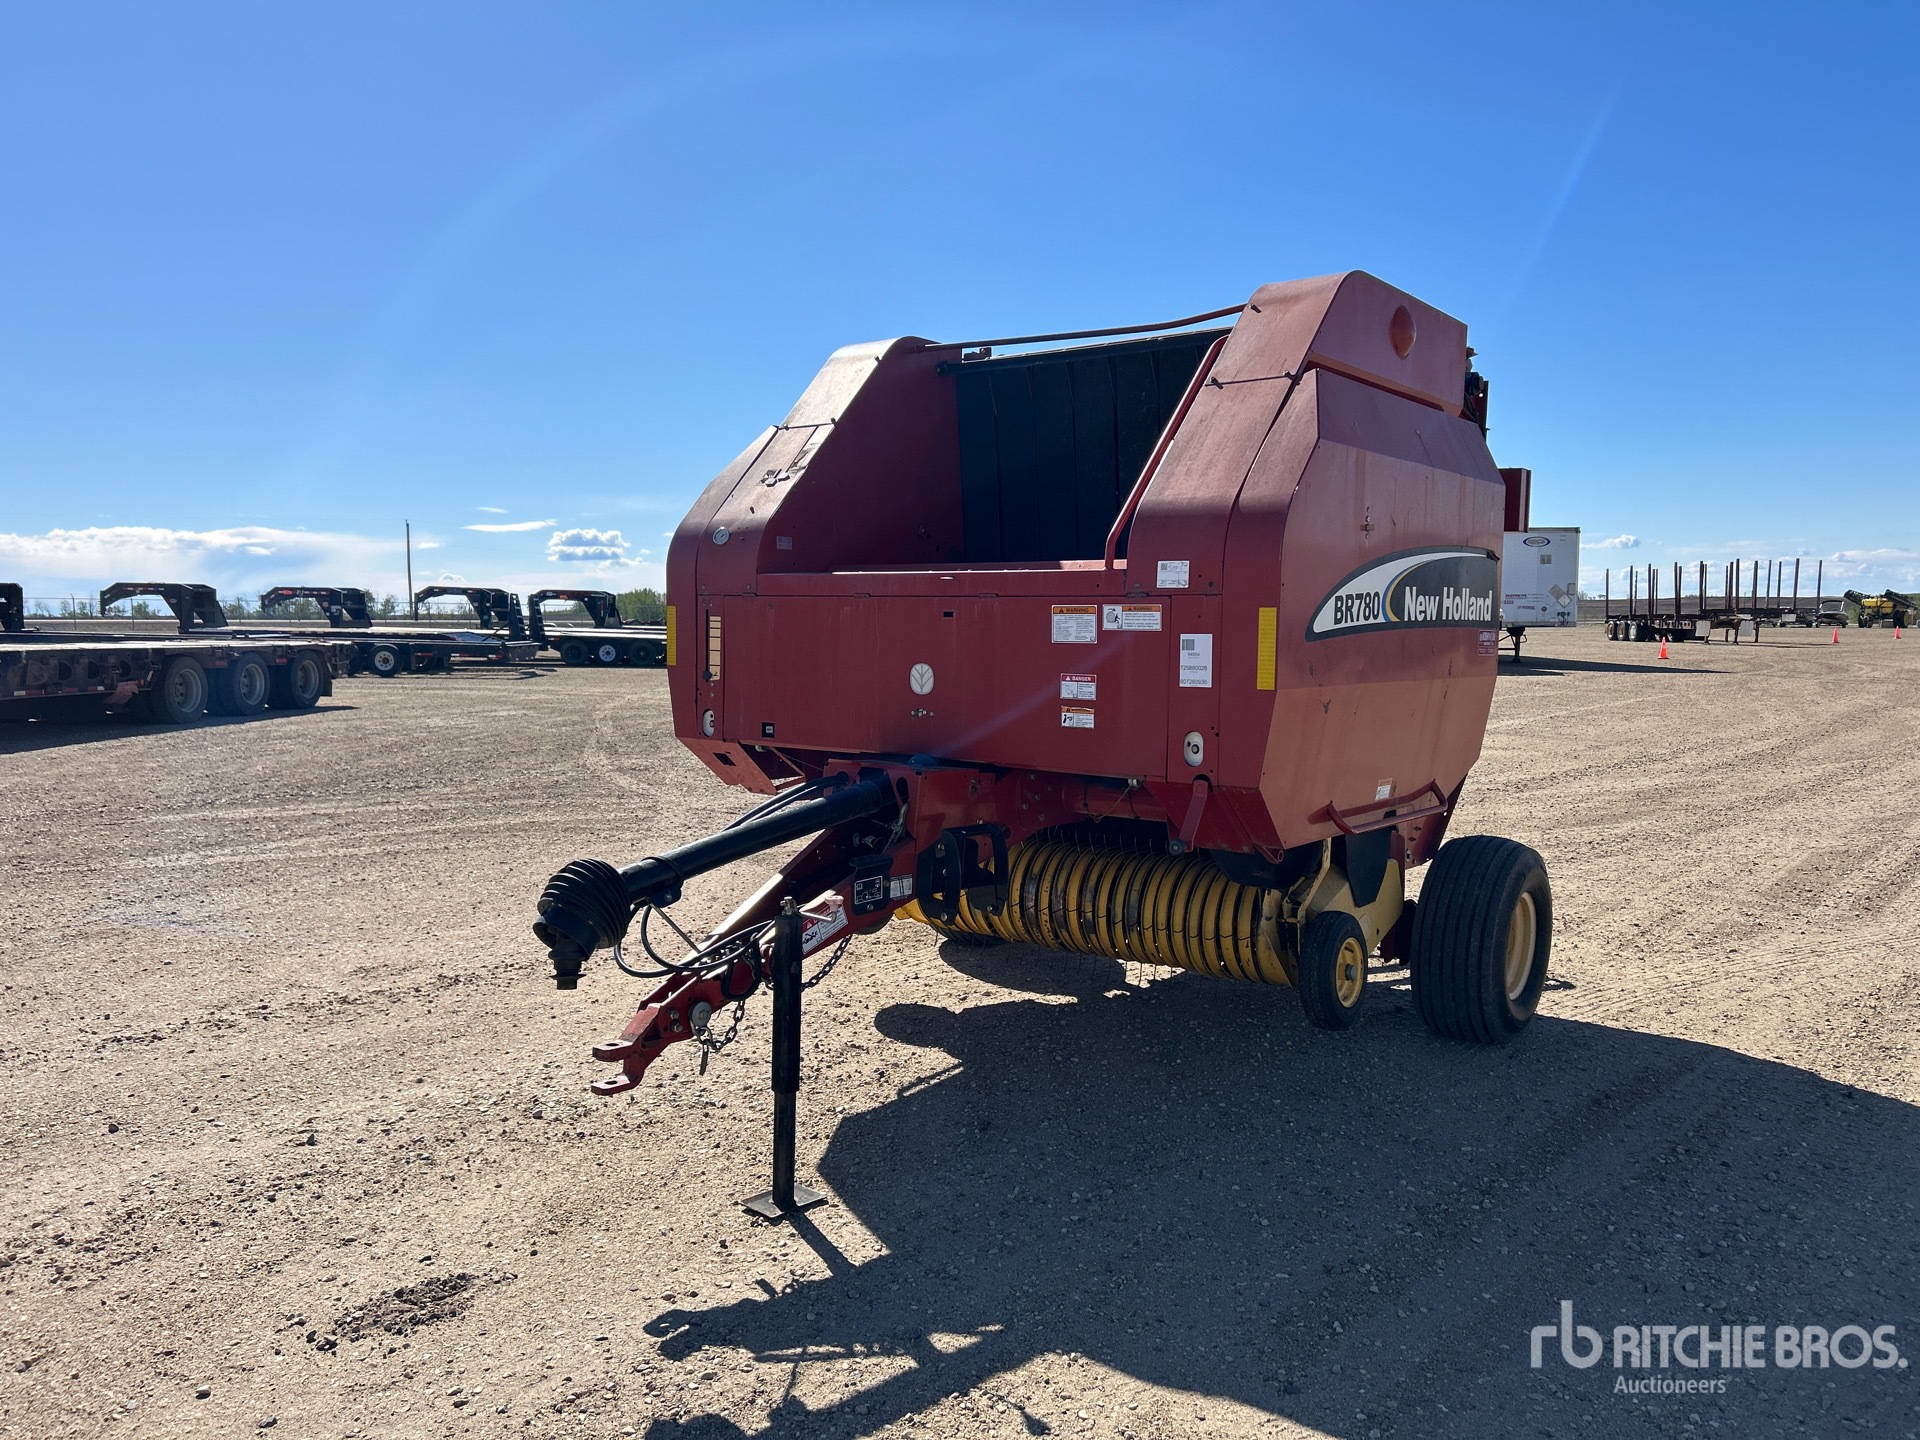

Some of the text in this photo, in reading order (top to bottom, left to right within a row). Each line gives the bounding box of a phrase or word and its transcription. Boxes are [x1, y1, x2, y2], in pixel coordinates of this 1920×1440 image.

[1333, 591, 1380, 625] BR780
[1404, 586, 1493, 622] New Holland
